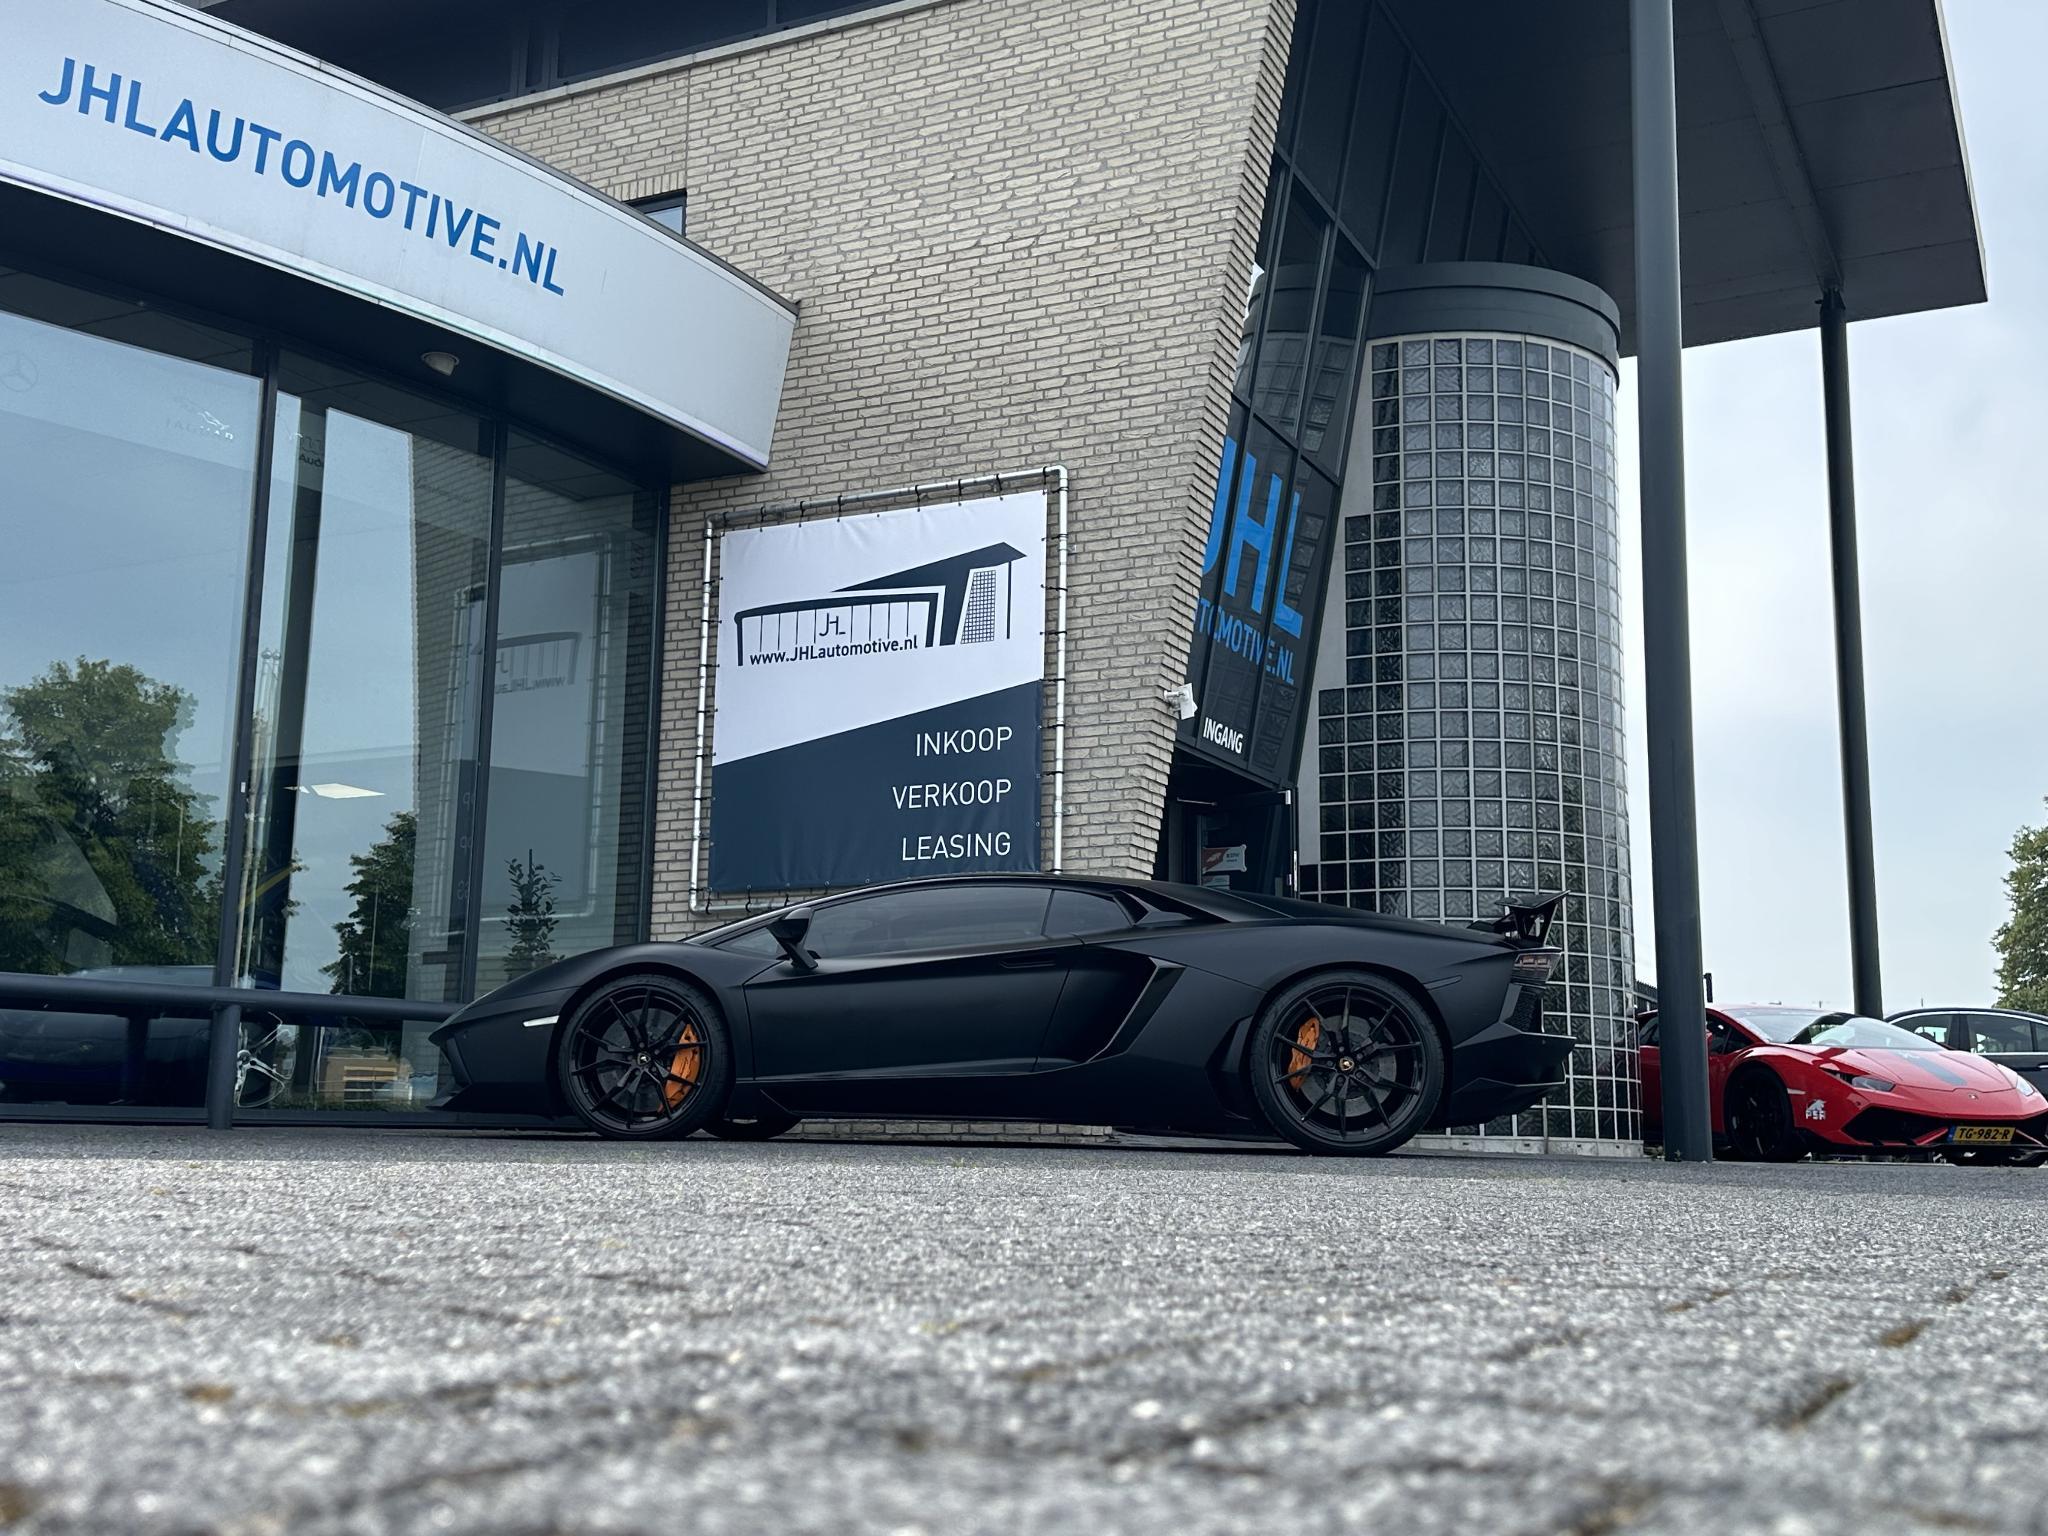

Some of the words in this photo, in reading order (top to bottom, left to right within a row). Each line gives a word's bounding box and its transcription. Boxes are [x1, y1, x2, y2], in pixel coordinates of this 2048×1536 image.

[38, 57, 564, 296] JHLAUTOMOTIVE.NL
[818, 612, 846, 637] JHL
[750, 634, 918, 666] www.JHLautomotive.nl
[916, 726, 1013, 757] INKOOP
[1203, 717, 1244, 754] INGANG
[892, 778, 1012, 810] VERKOOP
[902, 831, 1011, 861] LEASING
[1959, 1127, 2011, 1140] TG-982-R
